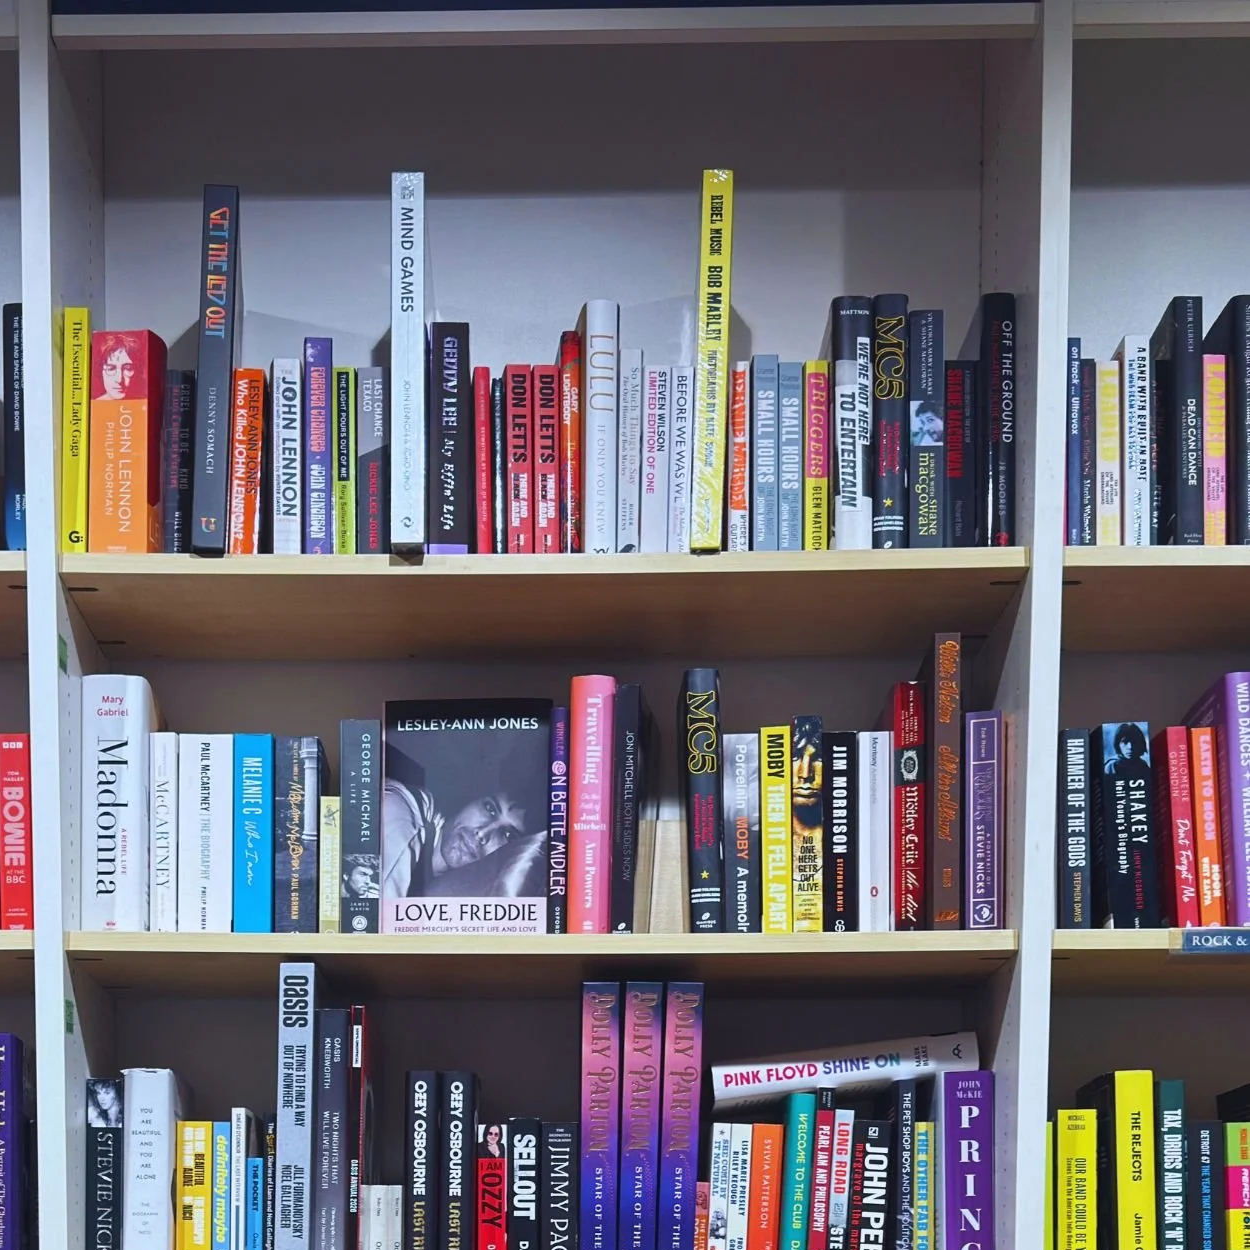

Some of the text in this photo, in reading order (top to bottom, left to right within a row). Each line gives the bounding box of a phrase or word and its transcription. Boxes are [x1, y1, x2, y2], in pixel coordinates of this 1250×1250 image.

[401, 207, 414, 312] MIND GAMES
[1002, 321, 1012, 442] OFF THE GROUND
[118, 406, 131, 532] JOHN LENNON
[840, 392, 857, 507] TO ENTERTAIN
[1188, 399, 1197, 485] DEAD CAN DANCE
[3, 787, 25, 866] BOWIE
[96, 736, 128, 897] Madonna
[361, 734, 371, 842] GEORGE MICHAEL
[833, 746, 847, 853] JIM MORRISON
[1067, 739, 1085, 866] HAMMER OF THE GODS
[1129, 780, 1148, 843] SHAKEY
[395, 904, 537, 922] LOVE, FREDDIE
[1192, 935, 1247, 946] ROCK &
[513, 1134, 536, 1220] SELLOUT
[548, 1146, 569, 1211] JIMMY
[863, 1144, 888, 1204] JOHN
[1132, 1112, 1142, 1181] THE REJECTS
[1134, 1213, 1143, 1244] Jamie
